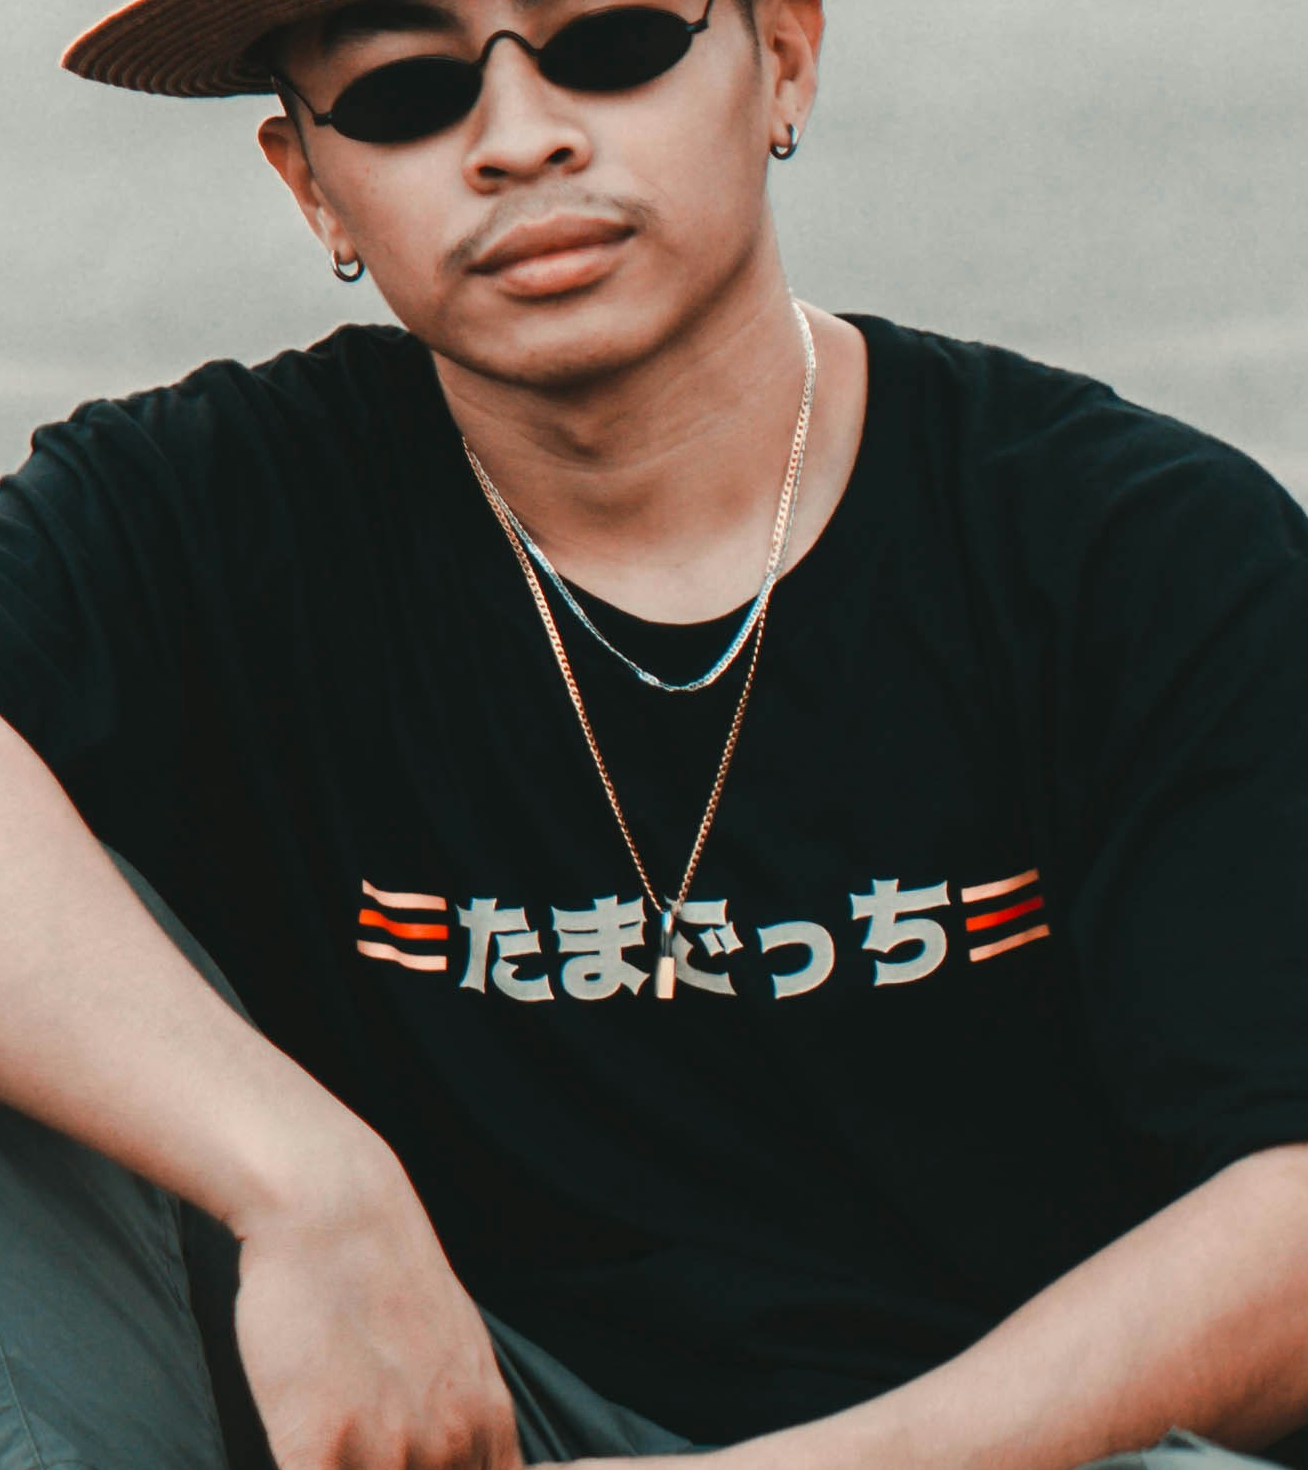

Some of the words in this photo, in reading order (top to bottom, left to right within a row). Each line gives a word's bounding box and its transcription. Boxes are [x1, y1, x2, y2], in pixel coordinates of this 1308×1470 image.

[457, 876, 951, 1002] たまごっち
